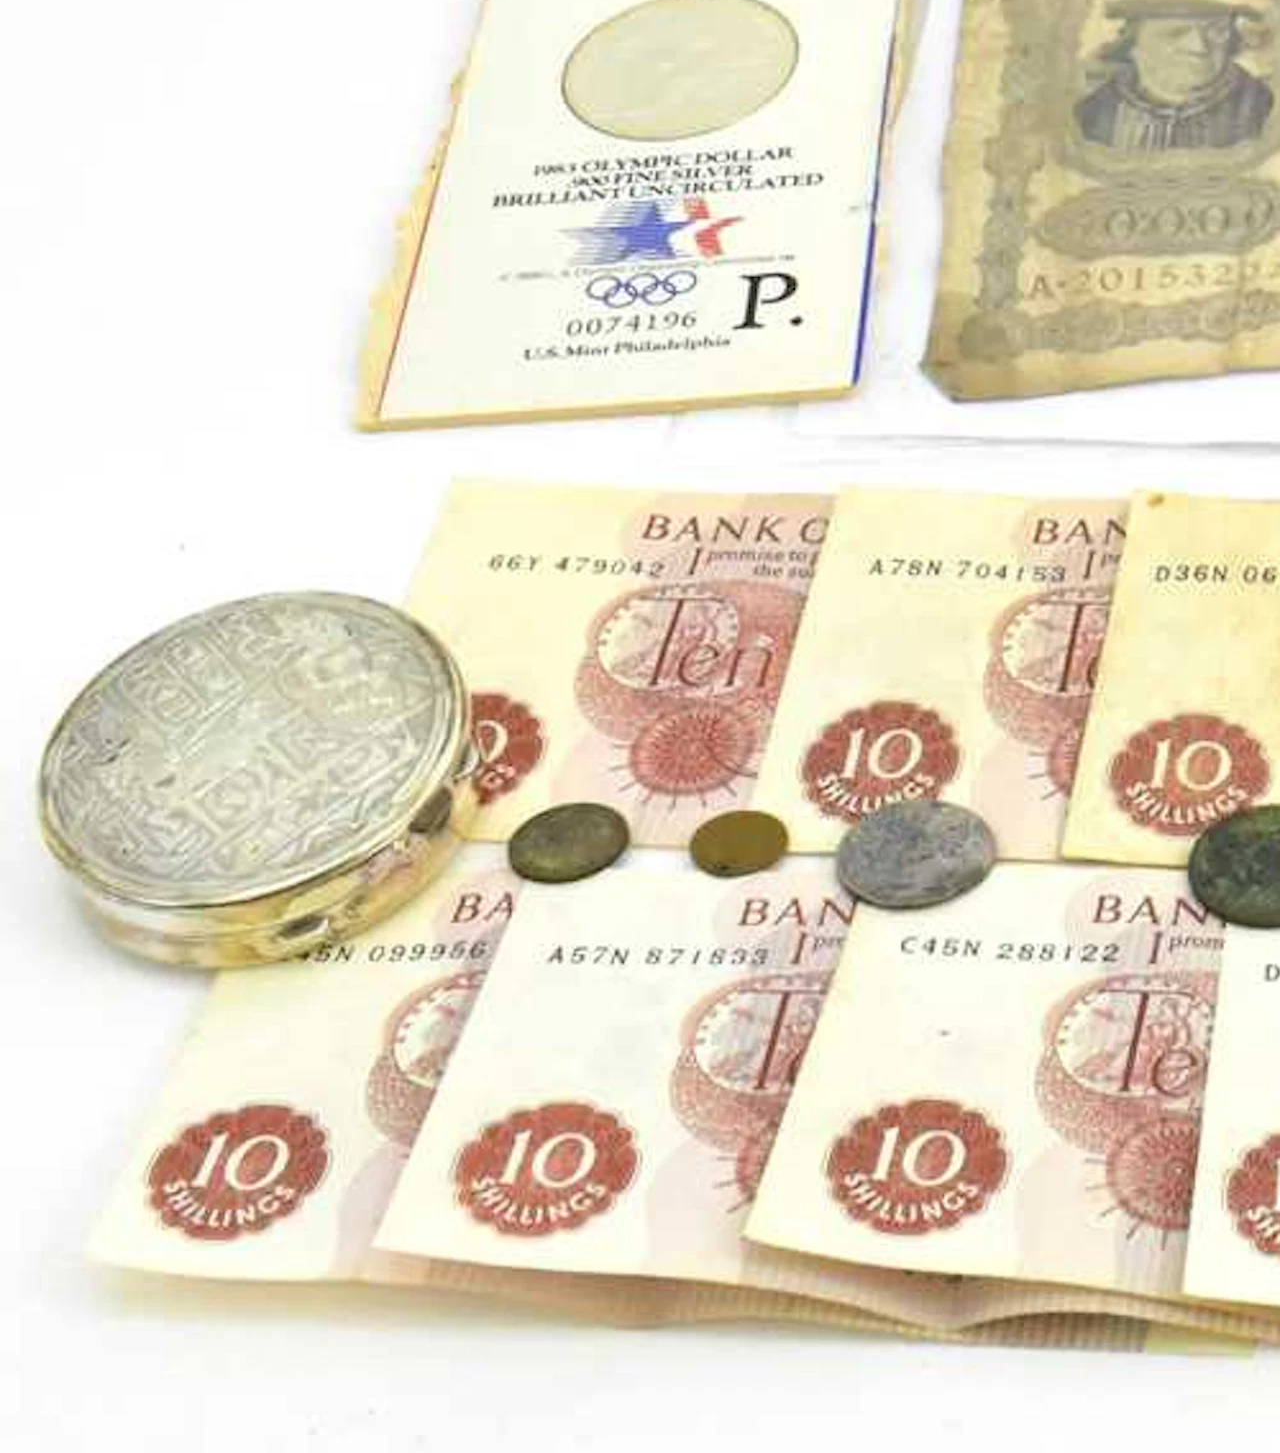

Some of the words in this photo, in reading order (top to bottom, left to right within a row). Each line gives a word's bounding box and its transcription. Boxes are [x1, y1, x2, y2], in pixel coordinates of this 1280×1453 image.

[581, 153, 691, 175] OLYMPIC
[694, 146, 795, 166] DOLLAR
[612, 168, 671, 186] FINE
[671, 163, 754, 182] SILVER
[491, 187, 624, 209] BRILLIANT
[627, 171, 826, 199] UNCIRCULATED
[733, 272, 805, 332] P.
[565, 310, 699, 338] 0074196
[613, 335, 733, 358] Philadelphia
[641, 513, 784, 544] BANK
[488, 553, 543, 573] 66Y
[553, 554, 666, 579] 479042
[705, 550, 786, 565] promise
[868, 557, 943, 577] A78N
[956, 561, 1067, 584] 704153
[1154, 564, 1229, 584] D36N
[630, 596, 774, 689] Ten
[840, 726, 923, 781] 10
[1148, 738, 1233, 792] 10
[1124, 780, 1252, 826] SHILLINGS
[547, 946, 630, 966] A57N
[645, 947, 769, 967] 871833
[899, 935, 983, 958] C45N
[996, 942, 1121, 964] 288122
[192, 1130, 290, 1192] 10
[498, 1128, 598, 1188] 10
[872, 1125, 967, 1187] 10
[161, 1177, 298, 1229] SHILLINGS
[470, 1175, 607, 1228] SHILLINGS
[841, 1171, 982, 1223] SHILLINGS
